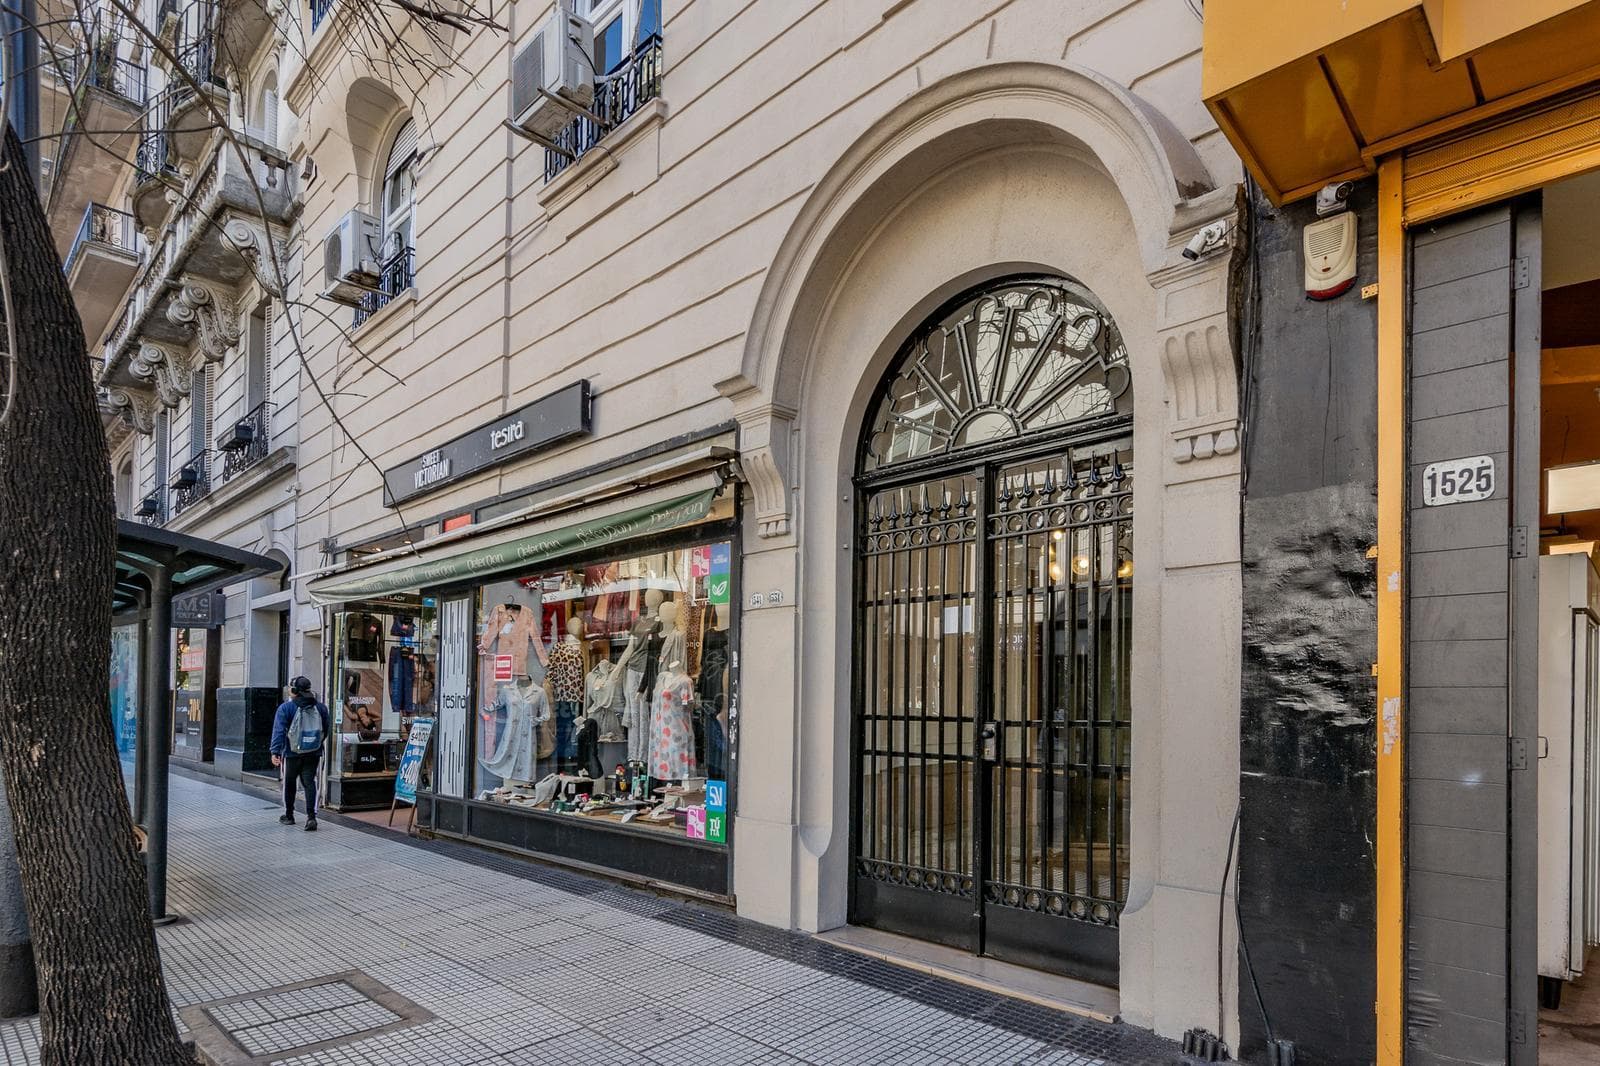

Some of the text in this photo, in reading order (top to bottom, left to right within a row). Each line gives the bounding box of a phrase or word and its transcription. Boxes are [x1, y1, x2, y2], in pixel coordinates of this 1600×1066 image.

[490, 420, 524, 450] tesira
[414, 458, 450, 489] VICTORIAN
[422, 450, 441, 468] SWEET
[1427, 464, 1492, 498] 1525
[443, 692, 466, 709] tesira
